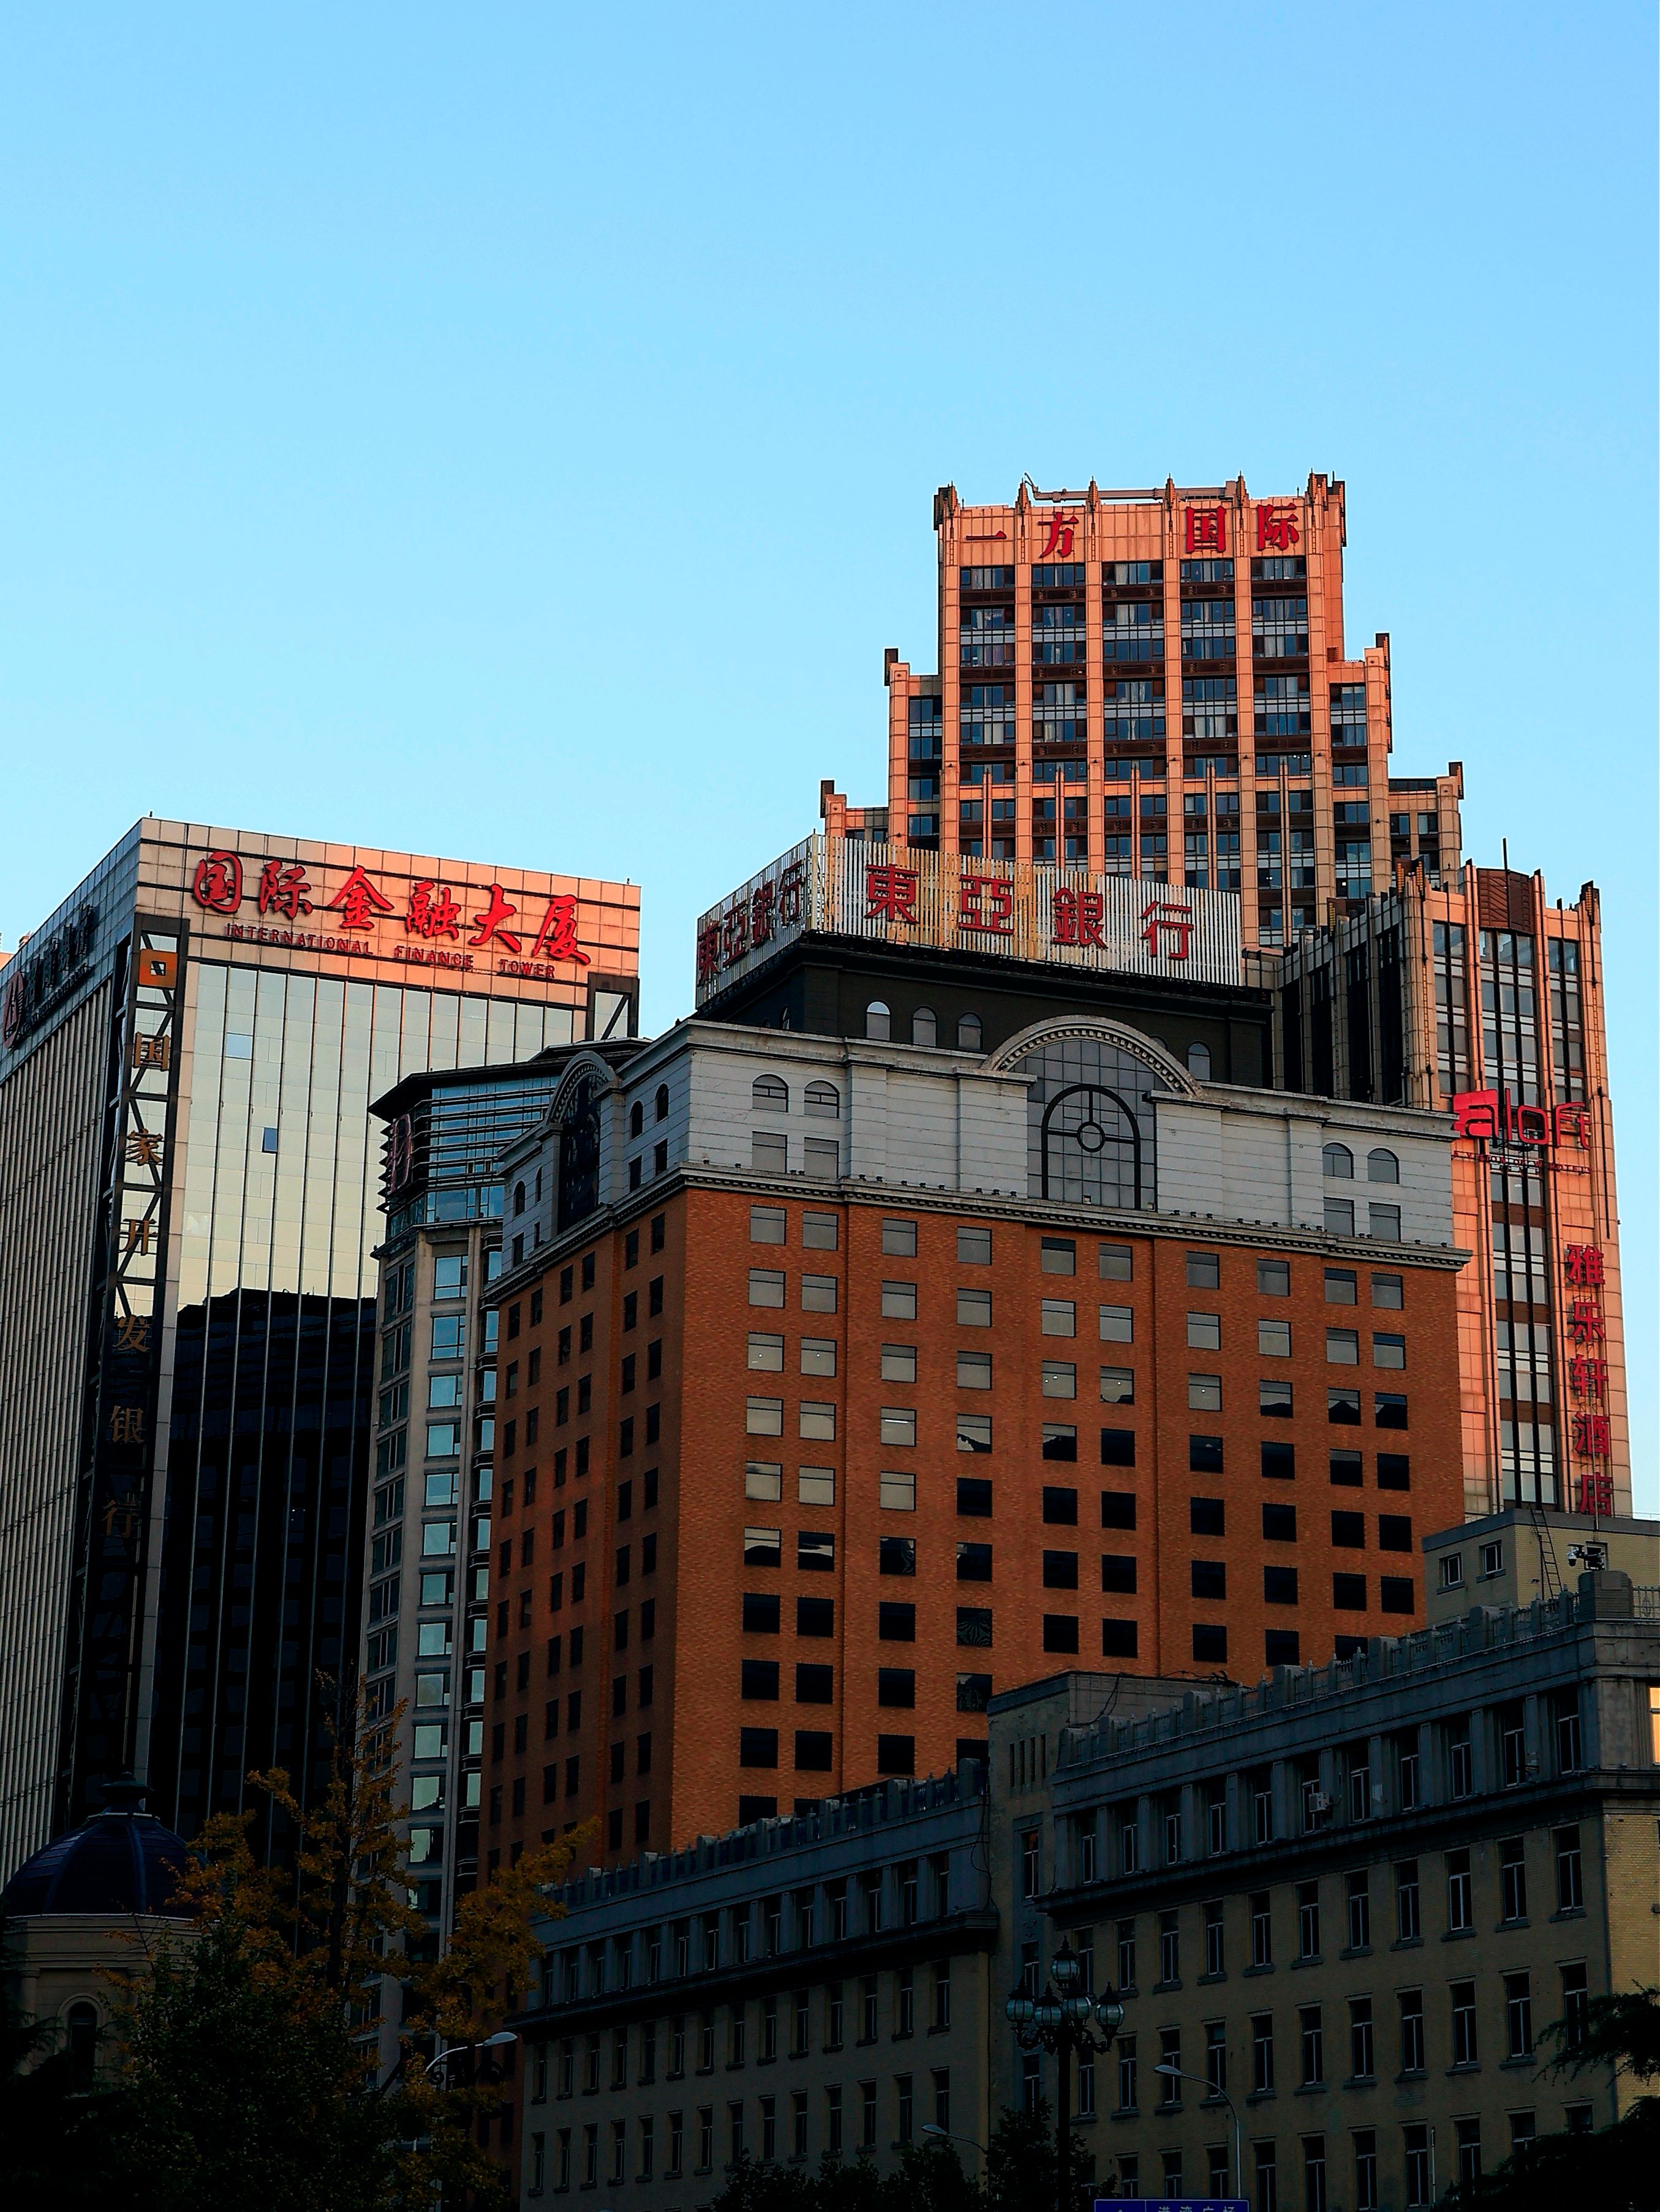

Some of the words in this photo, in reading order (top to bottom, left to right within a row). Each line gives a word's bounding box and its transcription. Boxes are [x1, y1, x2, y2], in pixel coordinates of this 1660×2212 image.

[193, 851, 591, 965] 国际金融大厦
[225, 923, 374, 955] INTERNATIONAL
[394, 945, 473, 968] FINANCE
[499, 958, 555, 979] TOWER
[697, 860, 804, 985] 東亞銀行
[865, 863, 1194, 960] 東亞銀行
[1452, 1088, 1591, 1150] aloft
[102, 1031, 171, 1538] 国家开发银行
[1567, 1244, 1613, 1516] 雅乐轩酒店
